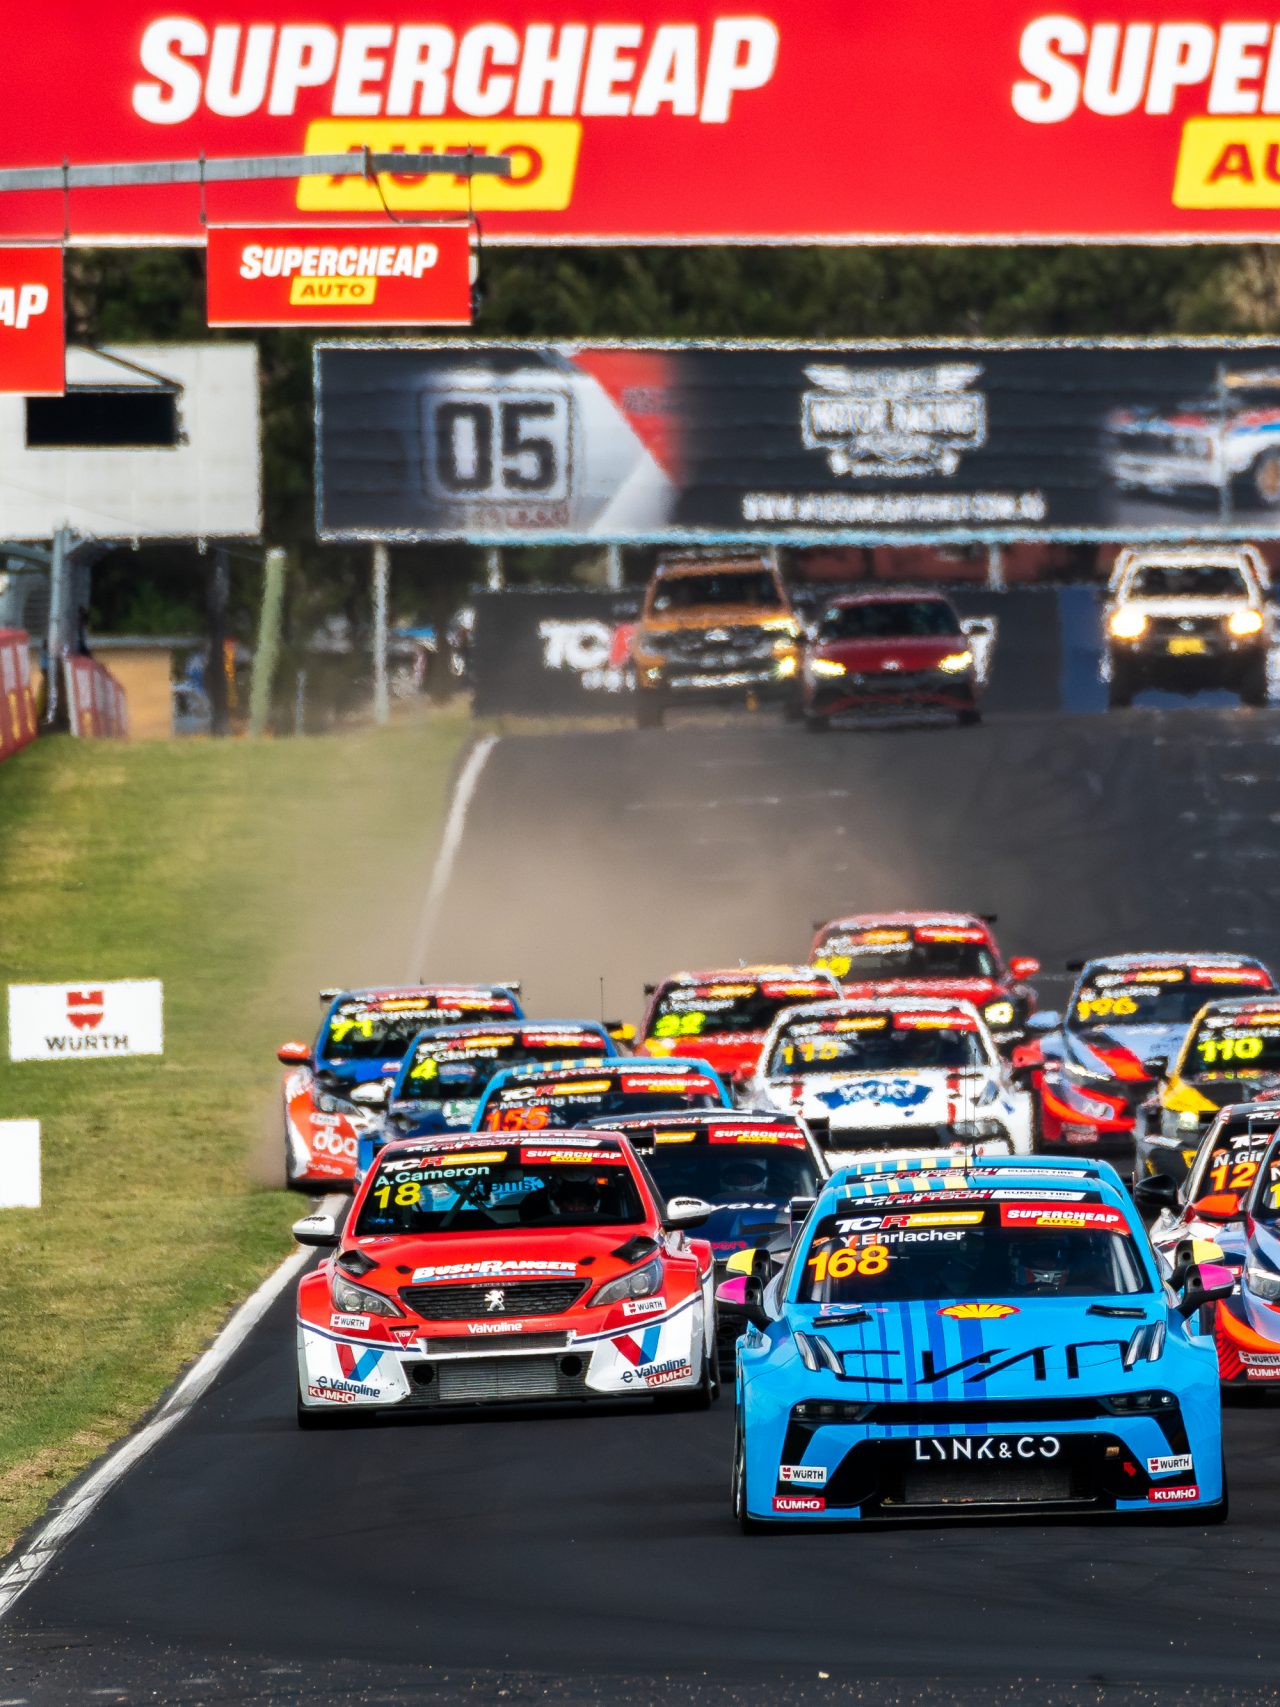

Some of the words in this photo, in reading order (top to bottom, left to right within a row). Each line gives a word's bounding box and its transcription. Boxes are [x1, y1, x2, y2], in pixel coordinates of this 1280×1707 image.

[132, 17, 778, 124] SUPERCHEAP
[240, 244, 438, 279] SUPERCHEAP
[300, 284, 365, 298] AUTO
[436, 402, 557, 491] 05
[1198, 1037, 1263, 1062] 110
[485, 1106, 549, 1131] 155
[381, 1155, 446, 1173] TCR
[526, 1150, 622, 1160] SUPERCHEAP
[375, 1166, 490, 1188] A.Cameron
[1210, 1161, 1258, 1191] 12
[373, 1182, 421, 1209] 18
[835, 1215, 911, 1233] TCR
[1006, 1209, 1119, 1224] SUPERCHEAP
[1042, 1218, 1080, 1226] AUTO
[841, 1230, 966, 1247] Y.Ehrlacher
[807, 1246, 889, 1282] 168
[467, 1322, 523, 1334] Valvoline
[634, 1358, 687, 1378] Valvoline
[647, 1367, 692, 1385] KUMHO
[309, 1386, 355, 1403] KUMHO
[330, 1377, 381, 1398] Valvoline
[1154, 1489, 1196, 1500] KUMHO
[776, 1500, 820, 1509] KUMHO
